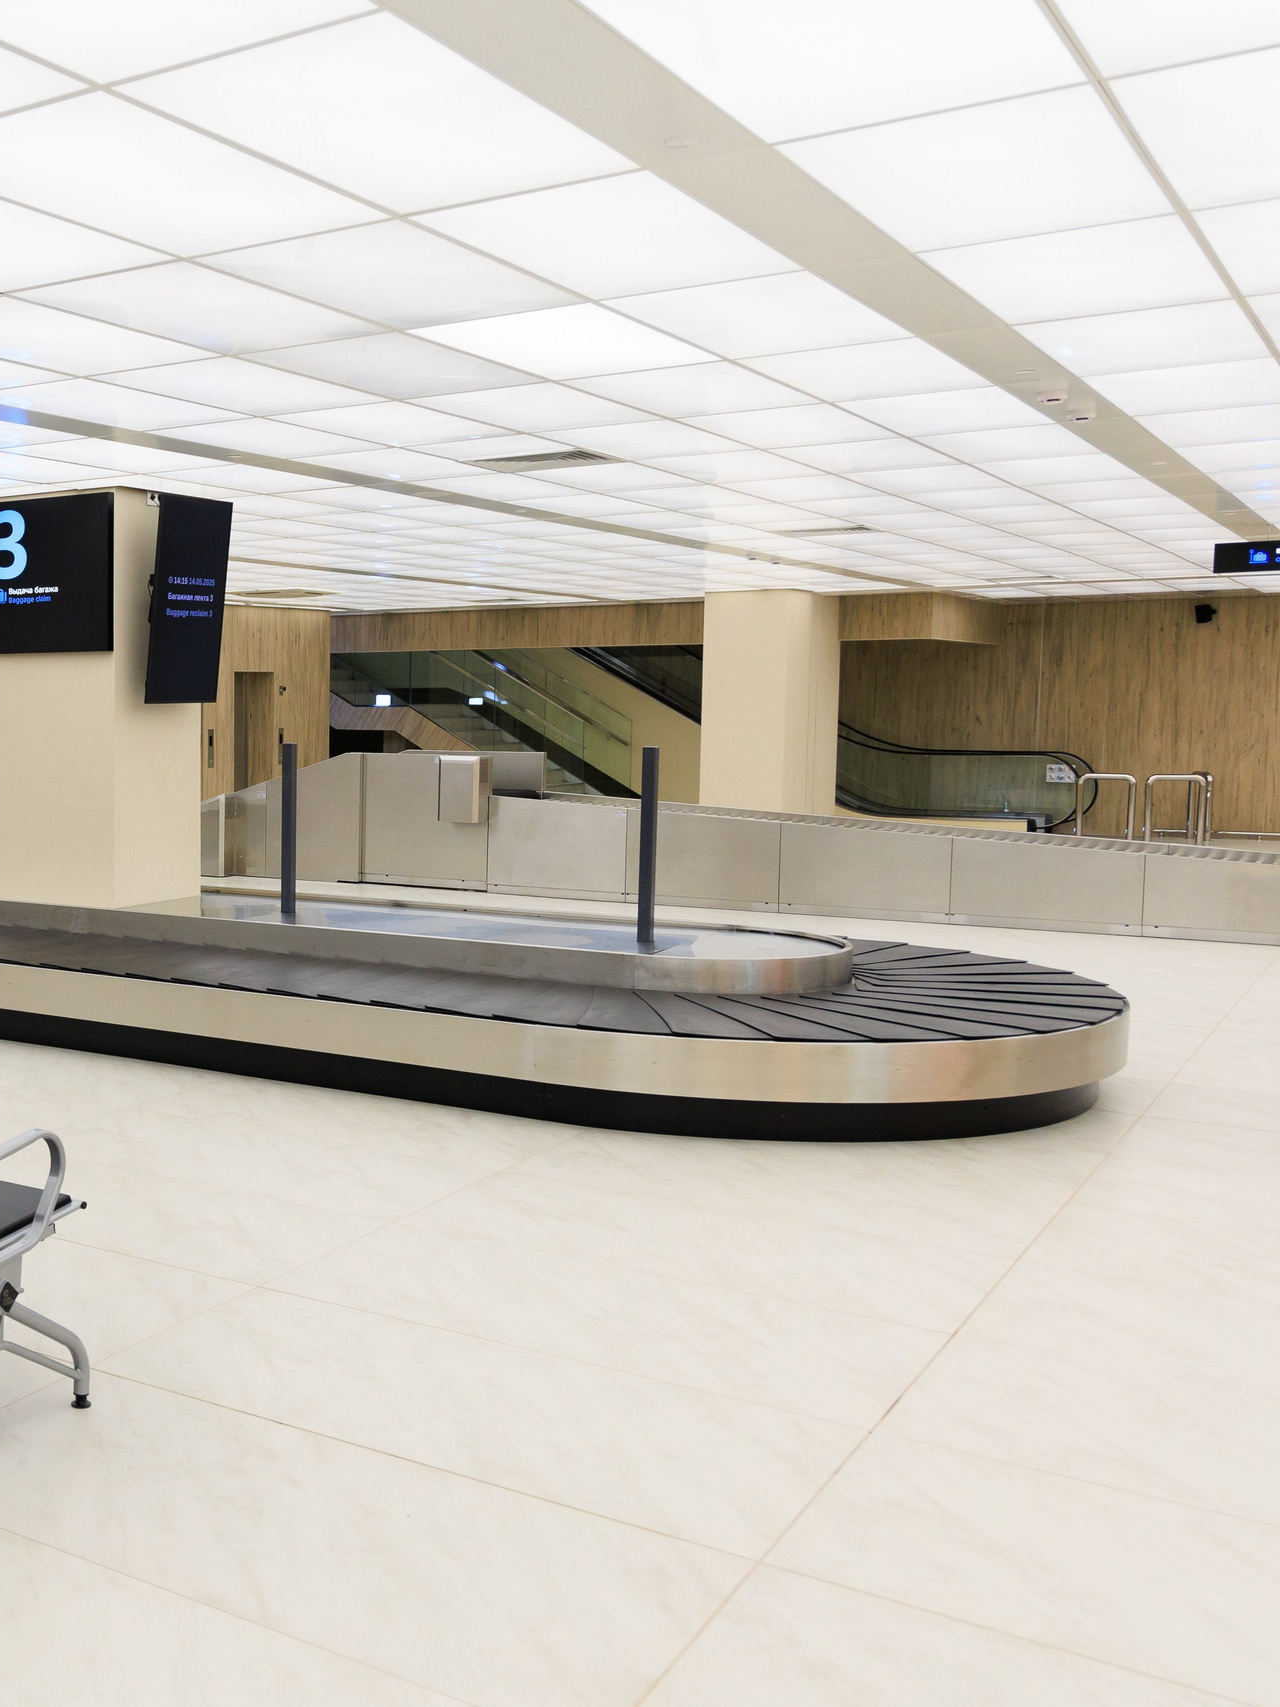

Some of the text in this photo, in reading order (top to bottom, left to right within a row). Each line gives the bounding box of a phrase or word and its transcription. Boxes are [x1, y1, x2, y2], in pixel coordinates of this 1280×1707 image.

[8, 585, 59, 595] Выдача багажа
[8, 596, 34, 605] Baggage
[168, 592, 193, 600] Багажная
[166, 608, 189, 618] Baggage
[190, 609, 208, 617] reclaim
